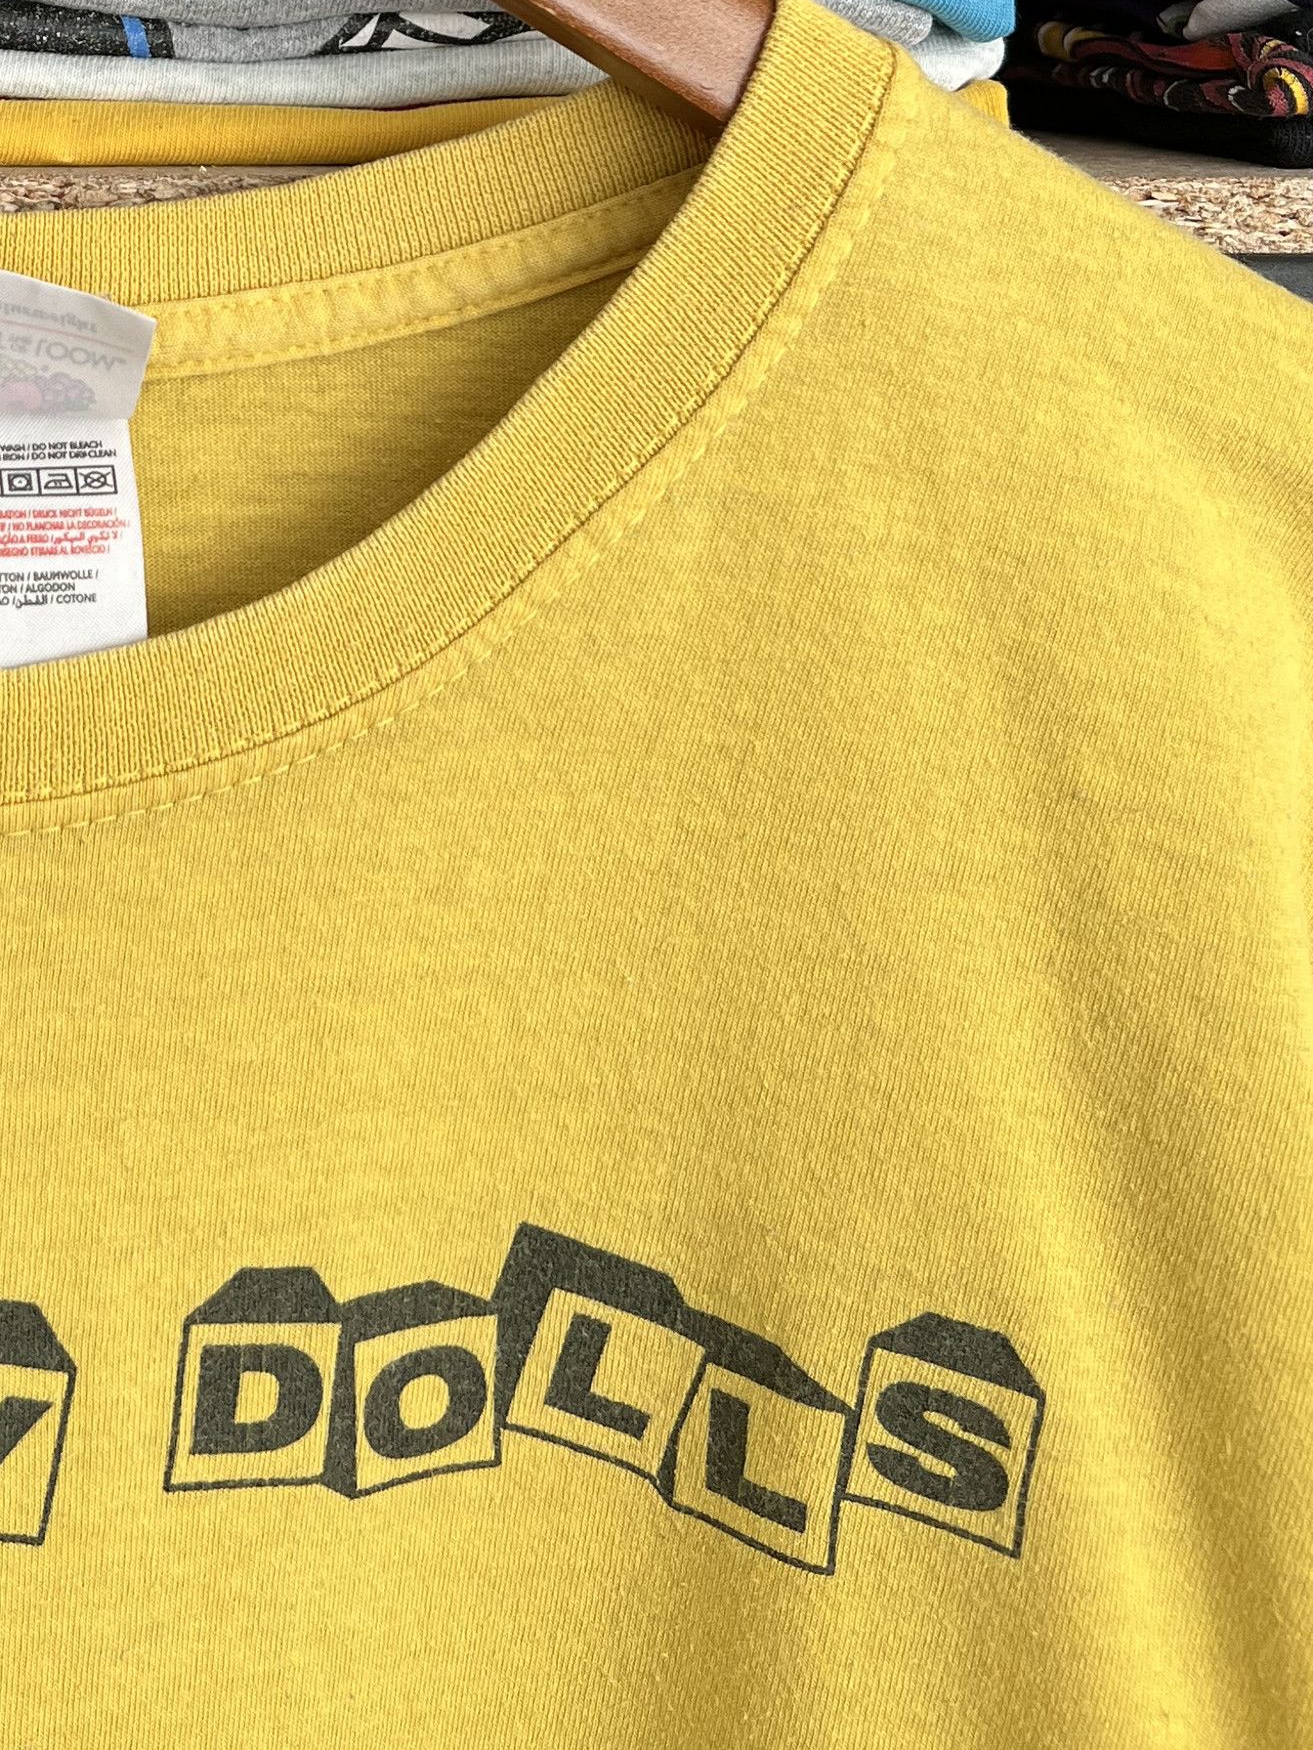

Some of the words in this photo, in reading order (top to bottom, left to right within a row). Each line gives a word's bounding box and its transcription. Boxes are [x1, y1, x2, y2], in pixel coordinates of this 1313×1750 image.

[32, 442, 47, 451] DO
[48, 441, 68, 450] NOT
[69, 440, 103, 450] BLEACH
[31, 451, 47, 460] DO
[48, 450, 68, 459] NOT
[12, 521, 25, 531] NO
[67, 520, 77, 529] LA
[33, 569, 94, 582] BAUMWOLLE
[25, 582, 76, 593] ALGODON
[55, 593, 97, 605] COTONE
[188, 1310, 1016, 1537] DOLLS
